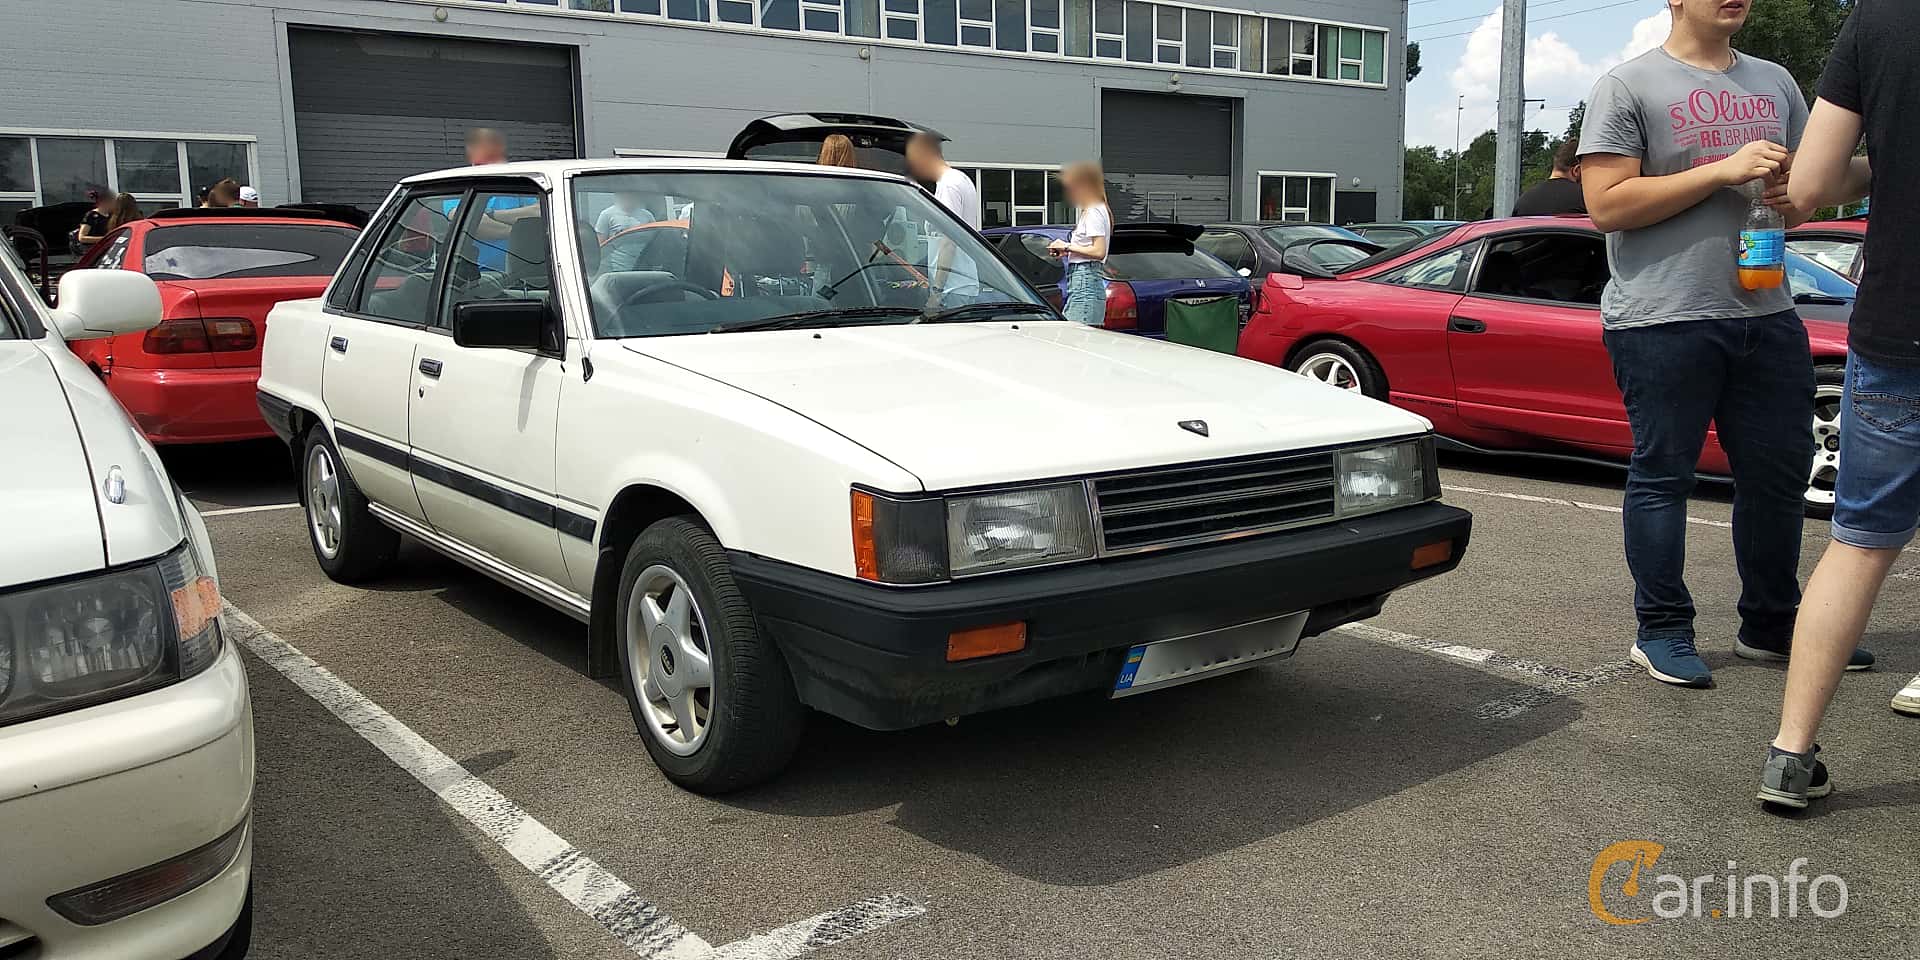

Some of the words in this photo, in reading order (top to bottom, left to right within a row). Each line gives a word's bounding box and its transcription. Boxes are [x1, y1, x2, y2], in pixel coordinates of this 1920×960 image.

[1670, 88, 1779, 130] s.Oliver
[1699, 125, 1766, 148] RG.BRAND
[1120, 672, 1133, 684] UA
